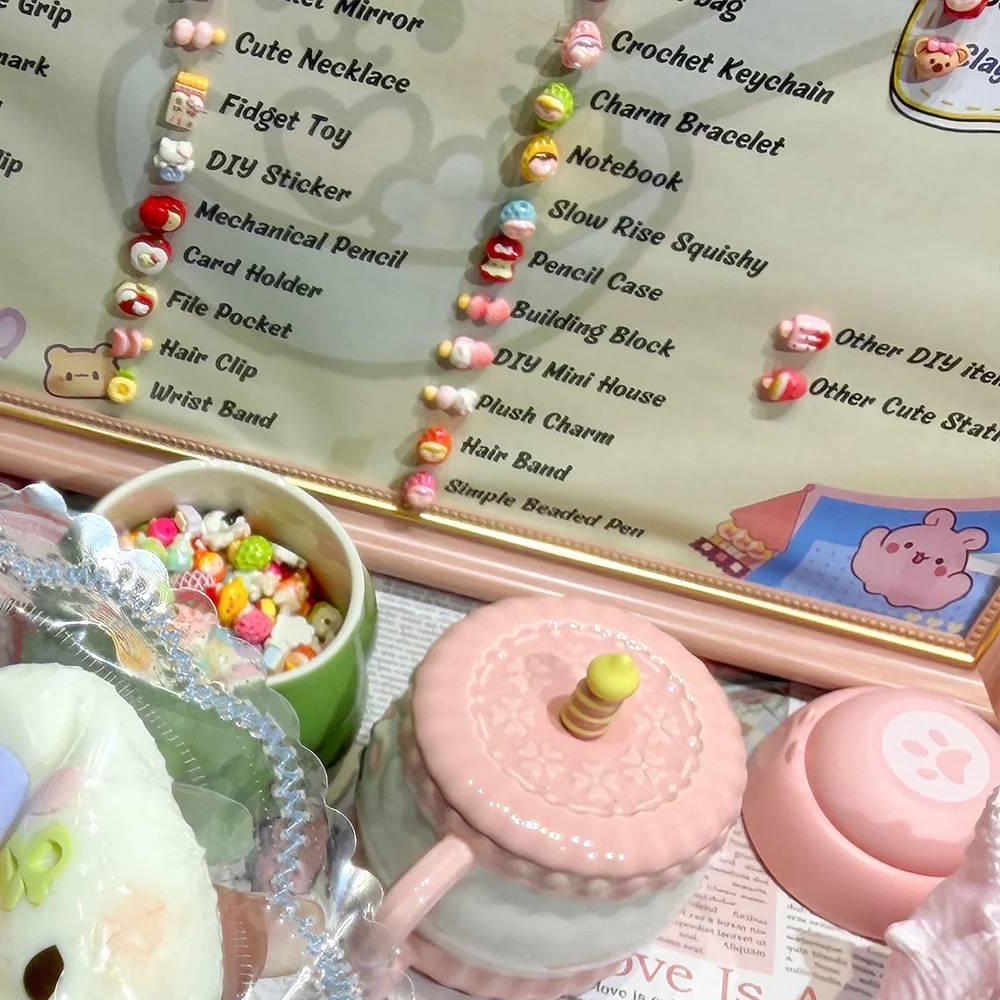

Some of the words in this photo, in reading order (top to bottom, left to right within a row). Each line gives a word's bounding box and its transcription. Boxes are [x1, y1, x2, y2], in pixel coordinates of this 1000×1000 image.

[18, 0, 72, 29] Grip
[333, 0, 424, 32] Mirror
[235, 32, 292, 65] Cute
[298, 47, 411, 94] Necklace
[612, 30, 715, 74] Crochet
[717, 55, 835, 105] Keychain
[219, 93, 300, 132] Fidget
[307, 113, 352, 150] Toy
[590, 89, 671, 130] Charm
[675, 110, 787, 157] Bracelet
[205, 149, 257, 179] DIY
[261, 163, 352, 202] Sticker
[566, 144, 684, 193] Notebook
[194, 200, 326, 252] Mechanical
[331, 234, 408, 270] Pencil
[548, 199, 607, 230] Slow
[612, 214, 666, 246] Rise
[671, 231, 770, 279] Squishy
[183, 245, 241, 277] Card
[245, 262, 323, 299] Holder
[528, 250, 604, 287] Pencil
[607, 270, 663, 302] Case
[167, 289, 209, 316] File
[214, 302, 293, 339] Pocket
[510, 300, 606, 344] Building
[609, 324, 676, 359] Block
[160, 338, 208, 366] Hair
[215, 352, 258, 382] Clip
[835, 327, 904, 359] Other
[906, 346, 963, 372] DIY
[492, 347, 542, 374] DIY
[542, 359, 596, 390] Mini
[596, 374, 668, 409] House
[809, 377, 876, 409] Other
[882, 396, 936, 425] Cute
[150, 381, 213, 413] Wrist
[218, 399, 277, 430] Band
[475, 393, 536, 425] Plush
[542, 411, 616, 448] Charm
[460, 436, 508, 462] Hair
[512, 450, 574, 483] Band
[444, 478, 516, 509] Simple
[521, 497, 602, 529] Beaded
[604, 516, 646, 540] Pen
